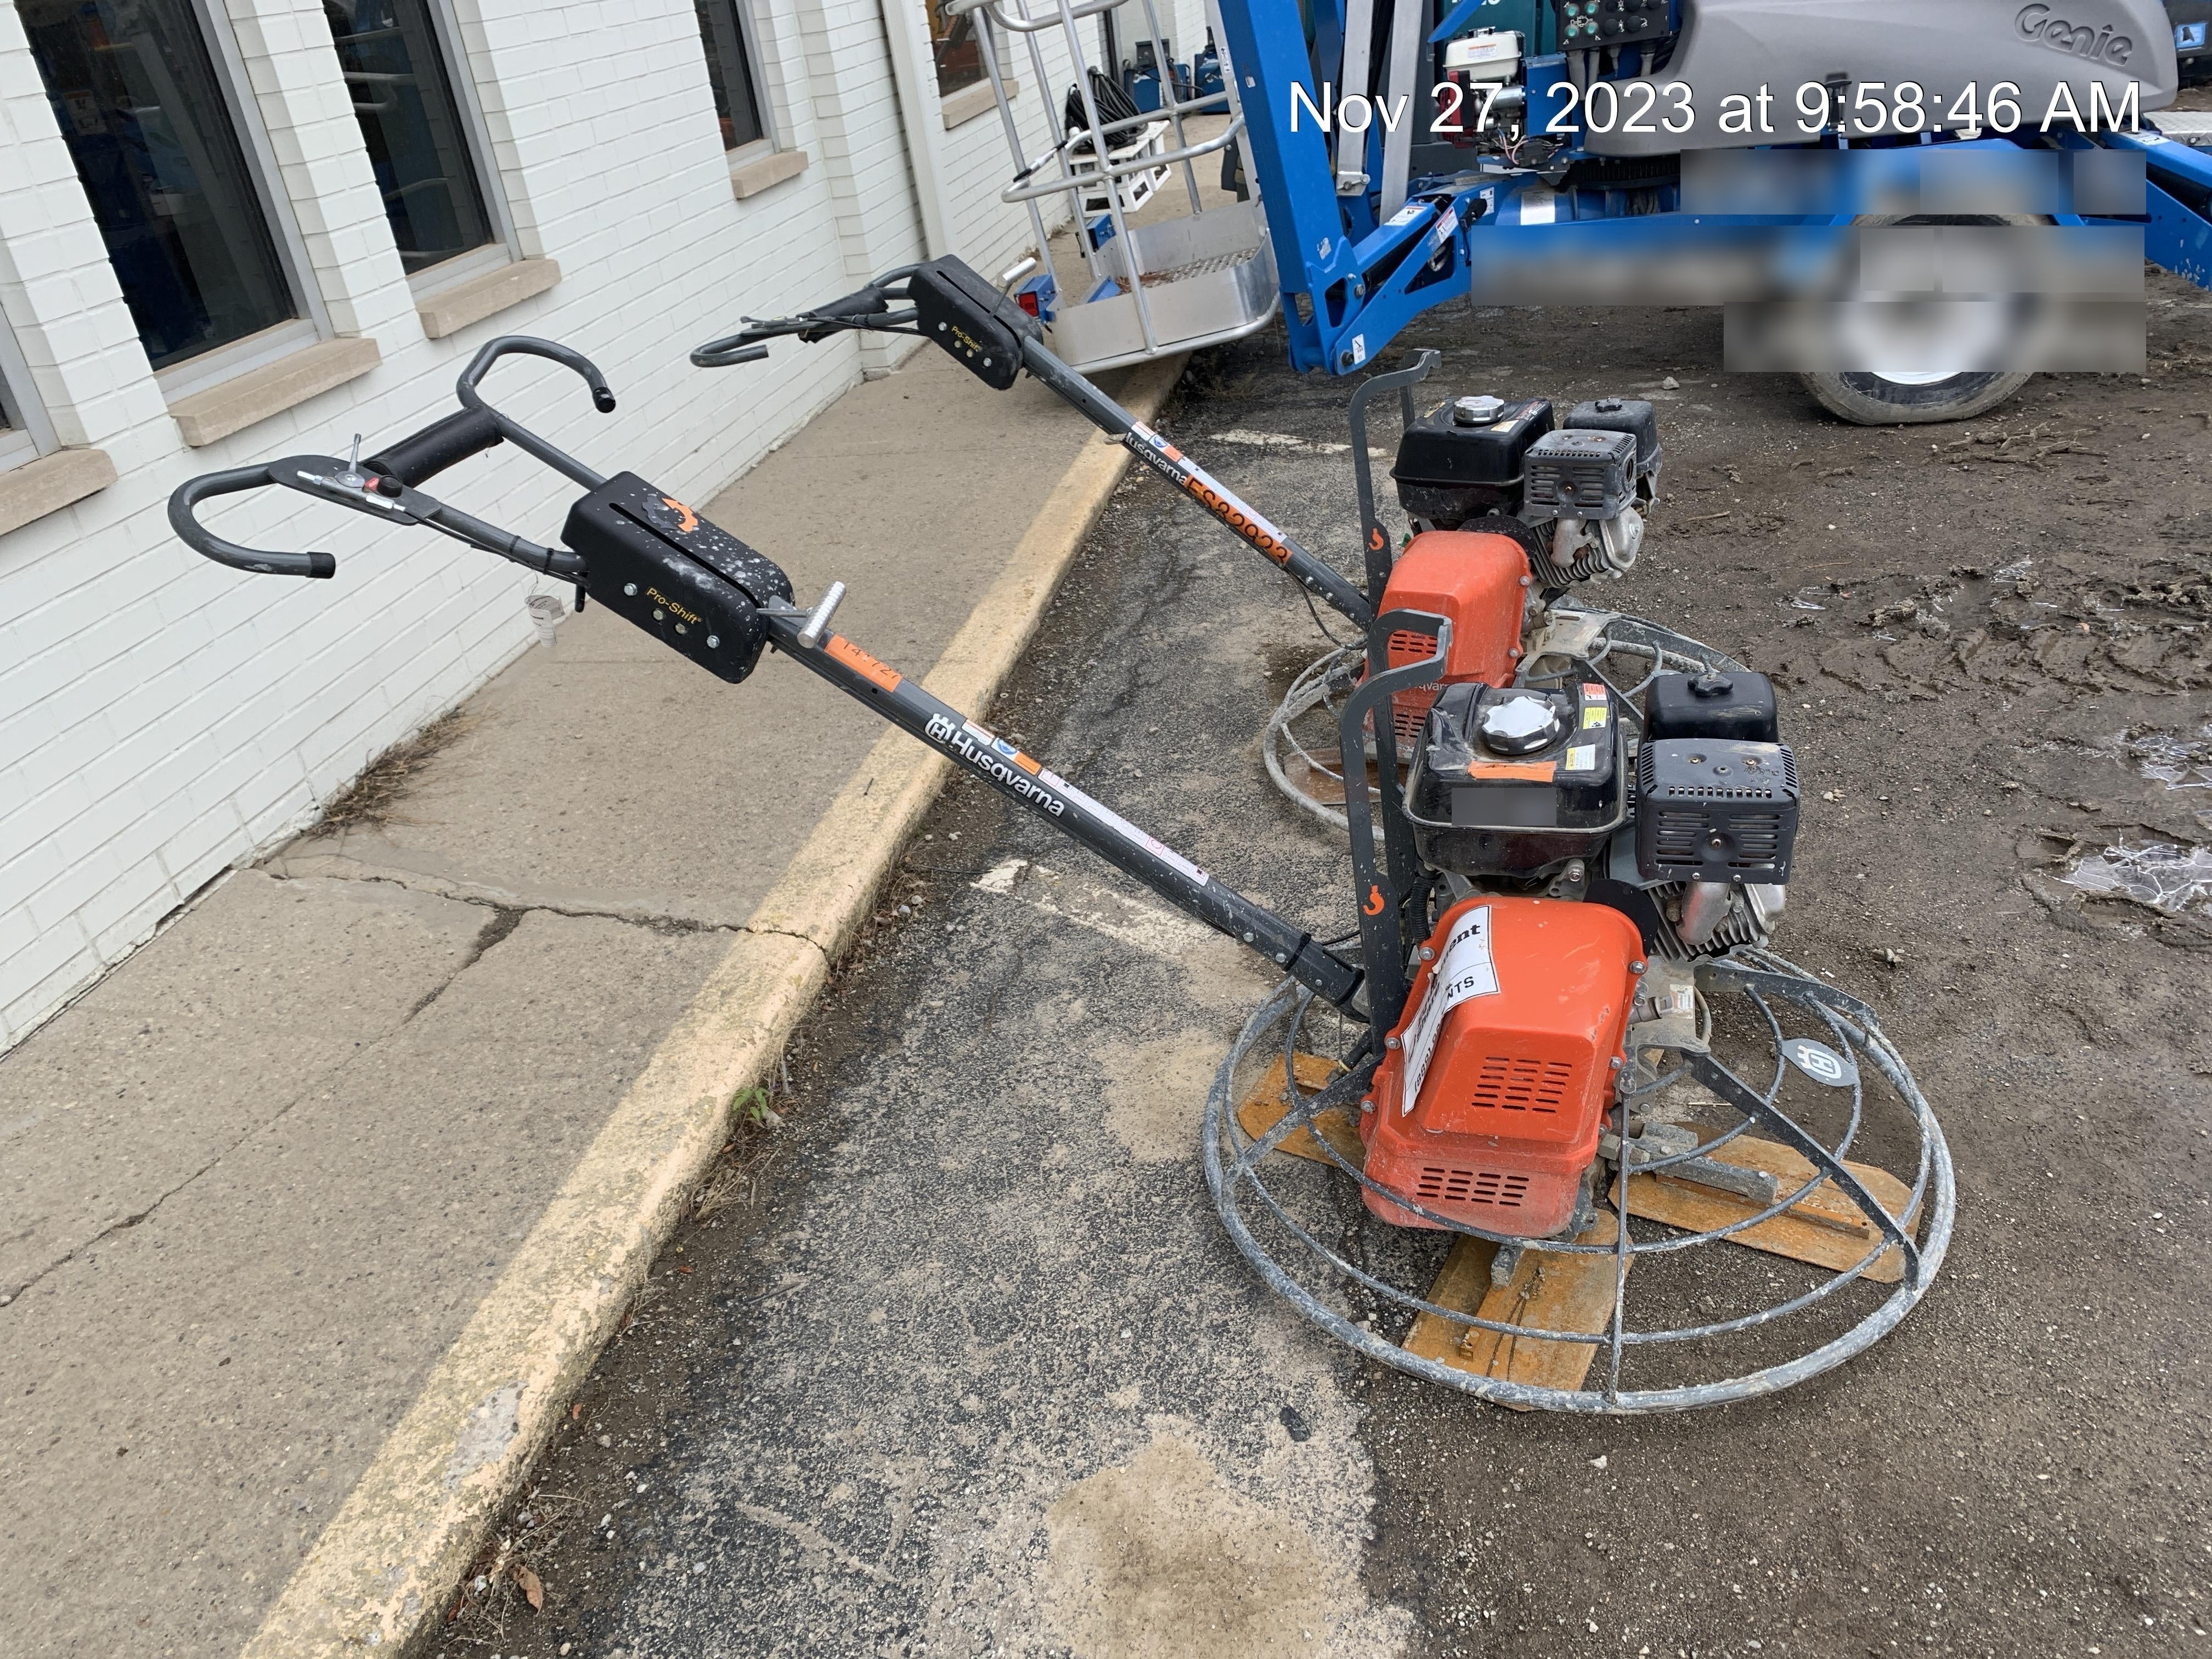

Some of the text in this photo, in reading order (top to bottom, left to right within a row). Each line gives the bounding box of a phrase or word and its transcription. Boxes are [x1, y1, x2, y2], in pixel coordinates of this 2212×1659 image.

[2015, 3, 2132, 66] Genie
[646, 588, 698, 624] Pro-Shift
[950, 730, 1065, 817] Husqvarna
